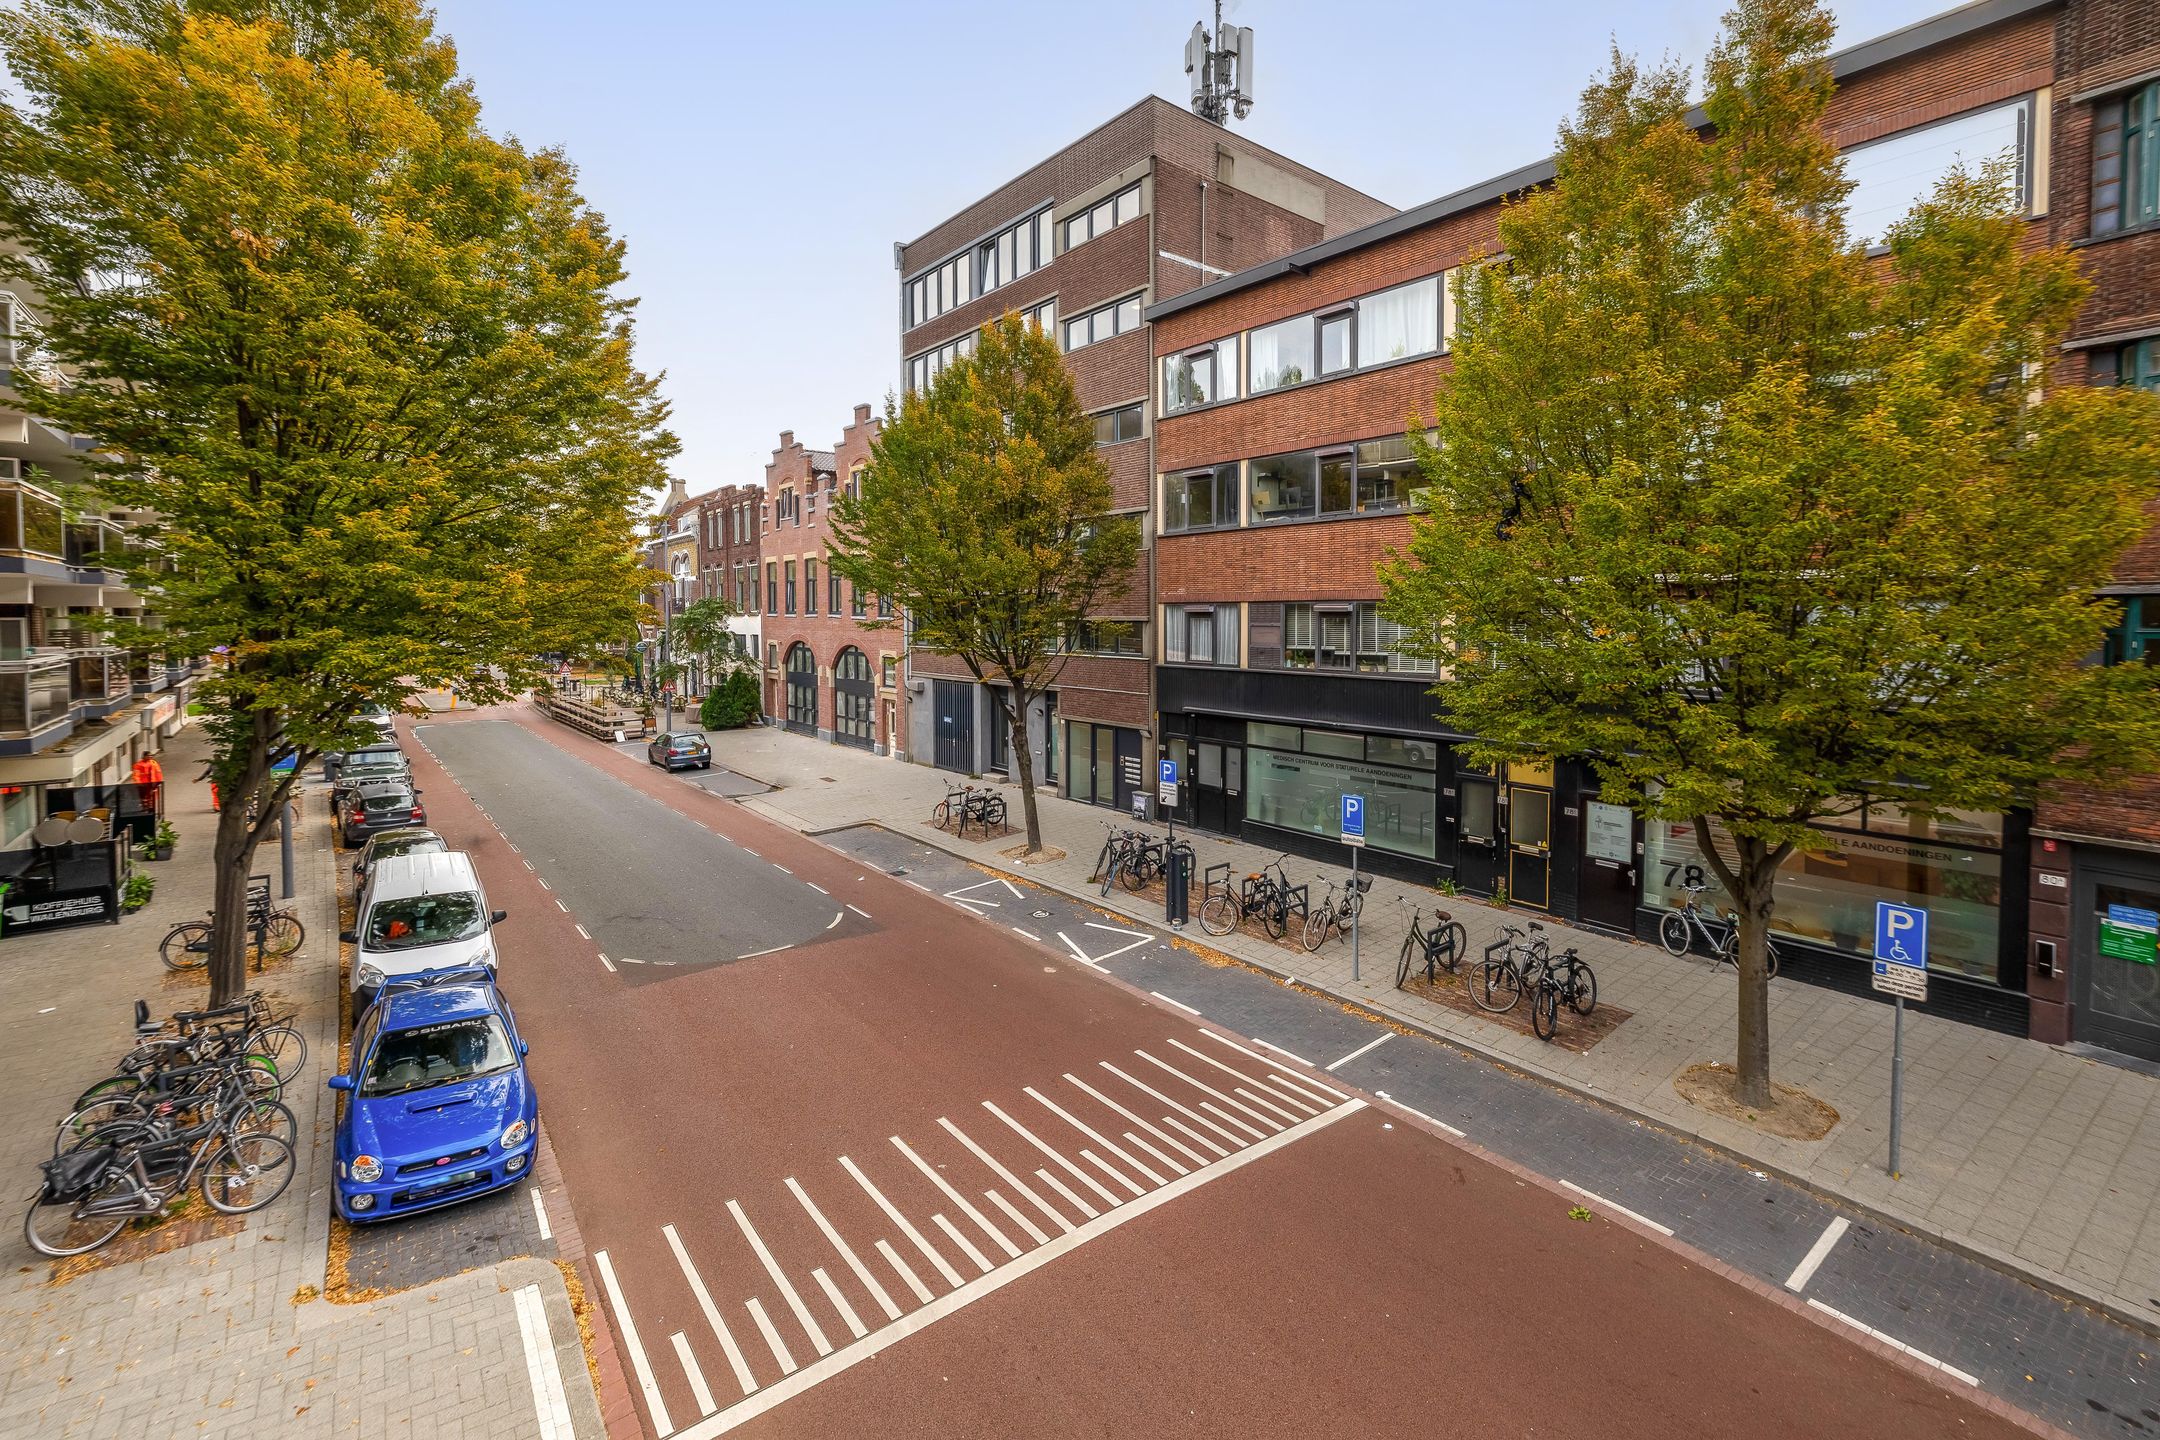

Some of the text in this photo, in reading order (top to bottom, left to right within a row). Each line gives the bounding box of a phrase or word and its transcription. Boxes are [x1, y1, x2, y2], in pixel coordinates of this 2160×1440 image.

[1163, 764, 1172, 780] P
[1272, 754, 1295, 763] MEDISCH
[1295, 758, 1319, 766] CENTRUM
[1366, 768, 1412, 780] AANDOENINGEN
[1346, 799, 1359, 818] P
[1851, 841, 1952, 862] AANDOENINGEN
[1660, 860, 1704, 891] 78
[32, 896, 102, 912] KOFFIEHUIS
[30, 906, 105, 923] WALENBURG
[1887, 909, 1914, 938] P
[420, 1020, 481, 1034] SUBARU
